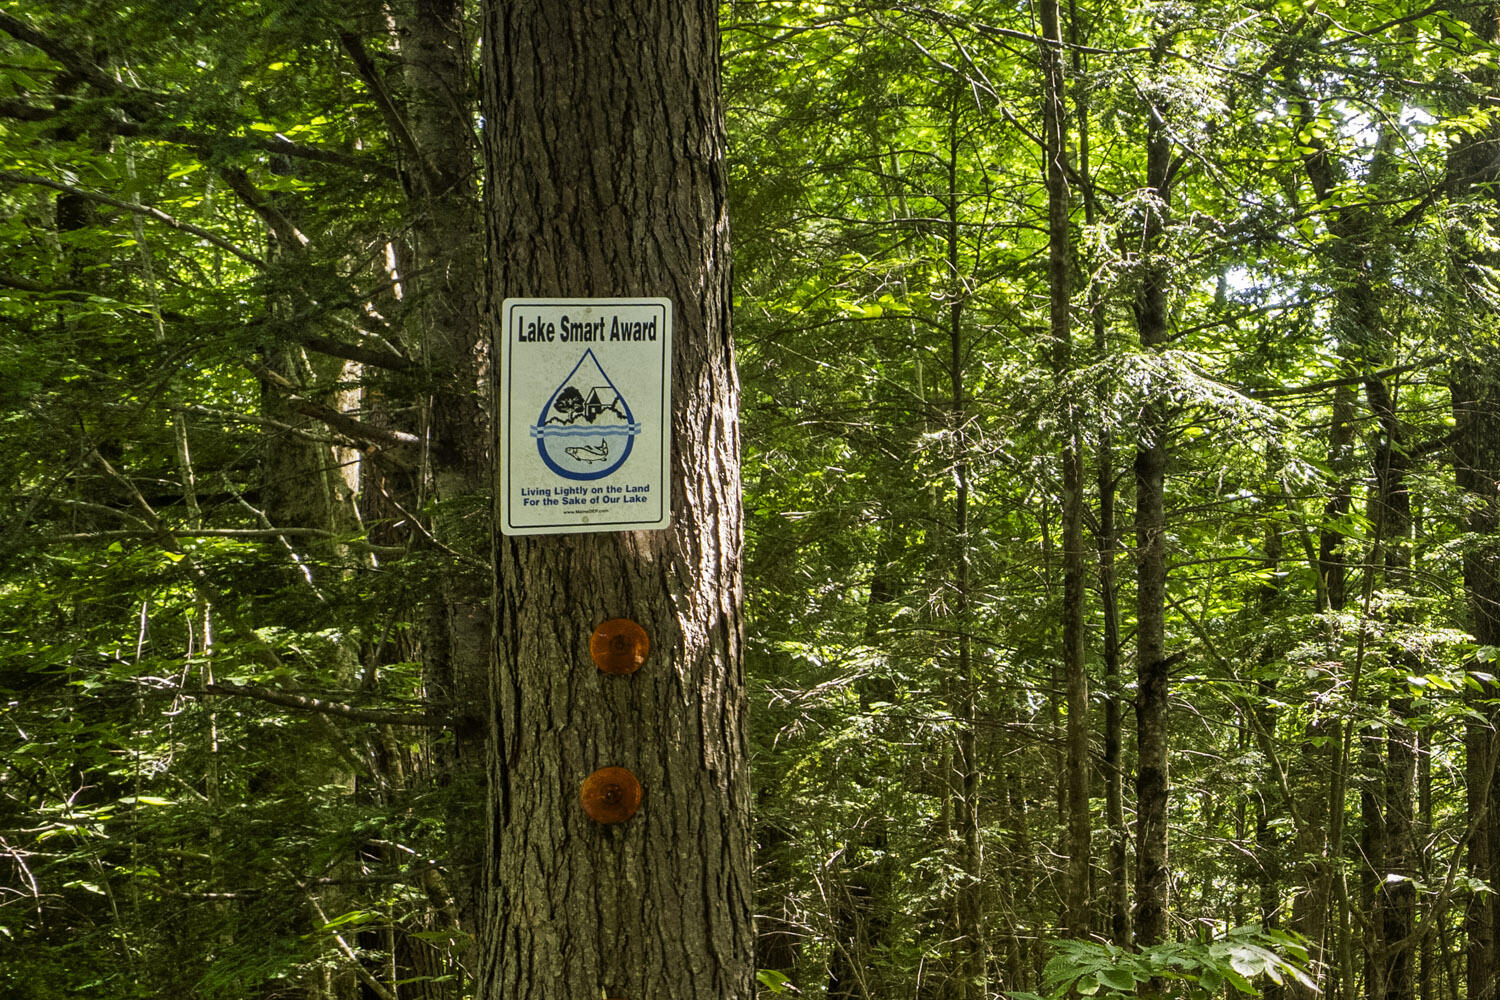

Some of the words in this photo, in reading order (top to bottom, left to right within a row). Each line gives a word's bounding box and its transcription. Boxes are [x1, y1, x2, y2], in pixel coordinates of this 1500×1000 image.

[518, 315, 555, 342] Lake
[560, 314, 605, 342] Smart
[609, 315, 657, 342] Award
[521, 487, 551, 497] Living
[554, 486, 588, 496] Lightly
[591, 486, 603, 494] on
[606, 485, 622, 493] the
[625, 484, 650, 493] Land
[523, 498, 540, 506] For
[542, 497, 559, 506] the
[562, 496, 587, 505] Sake
[590, 495, 600, 504] of
[602, 495, 620, 504] Our
[623, 494, 648, 503] Lake
